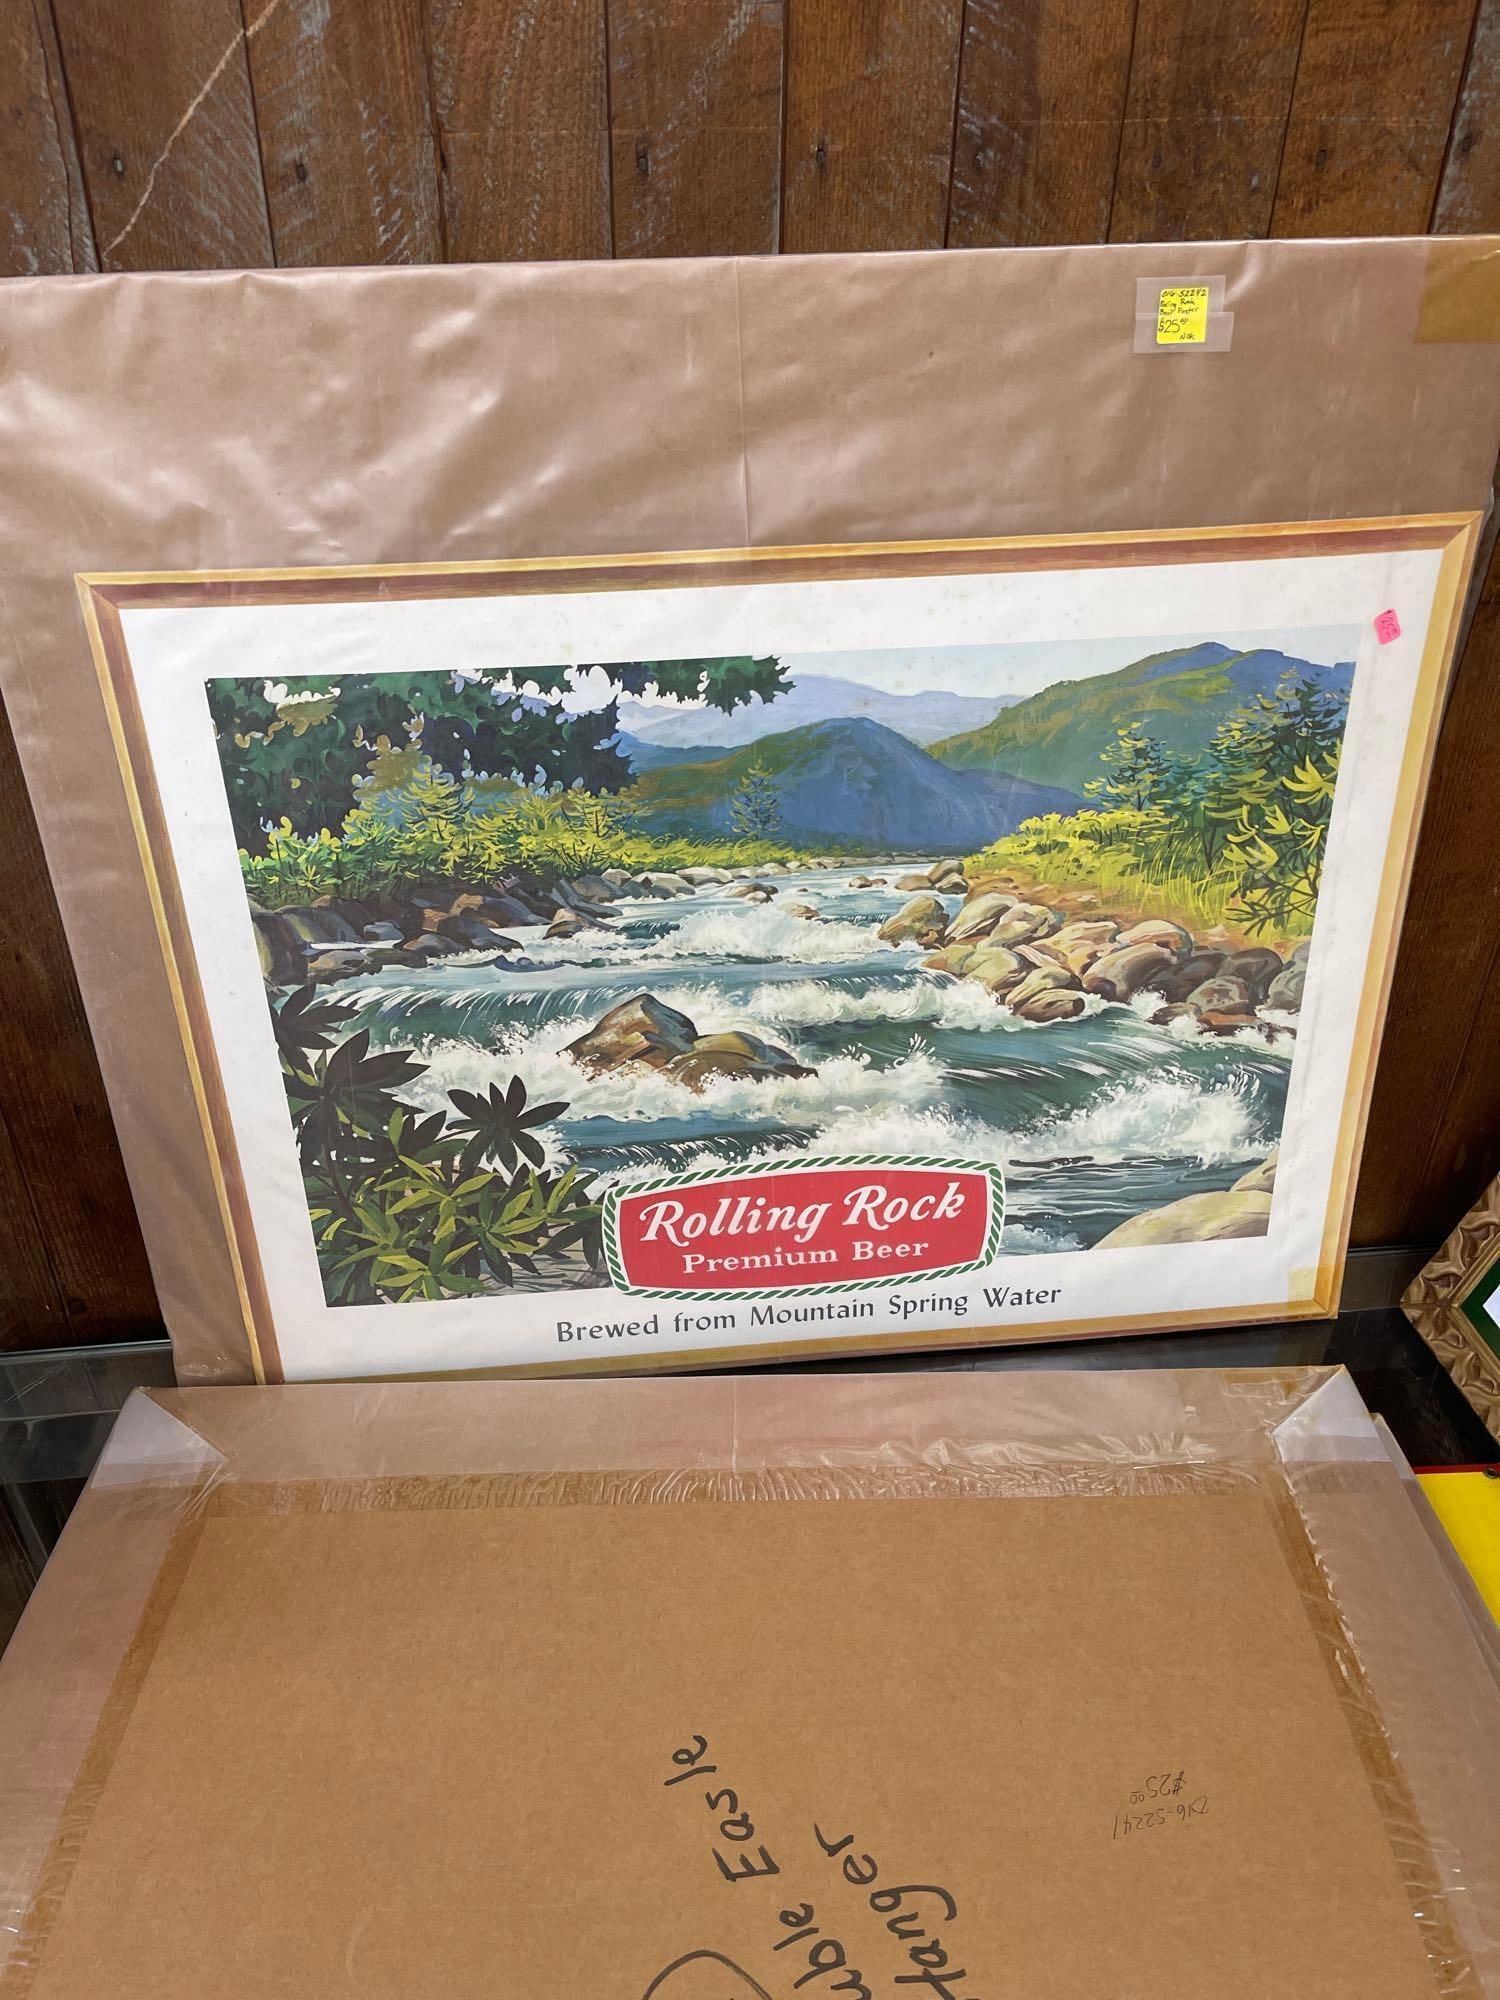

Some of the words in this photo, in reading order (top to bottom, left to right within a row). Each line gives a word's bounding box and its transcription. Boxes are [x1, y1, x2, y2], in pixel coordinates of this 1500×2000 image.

[639, 1196, 832, 1248] Rolling
[841, 1182, 966, 1231] Rock
[681, 1248, 839, 1275] Premium
[851, 1239, 930, 1262] Beer
[556, 1315, 659, 1343] Brewed
[674, 1310, 736, 1334] from
[750, 1297, 874, 1327] Mountain
[888, 1292, 969, 1317] Spring
[982, 1285, 1062, 1309] Water
[664, 1734, 780, 1882] Easle
